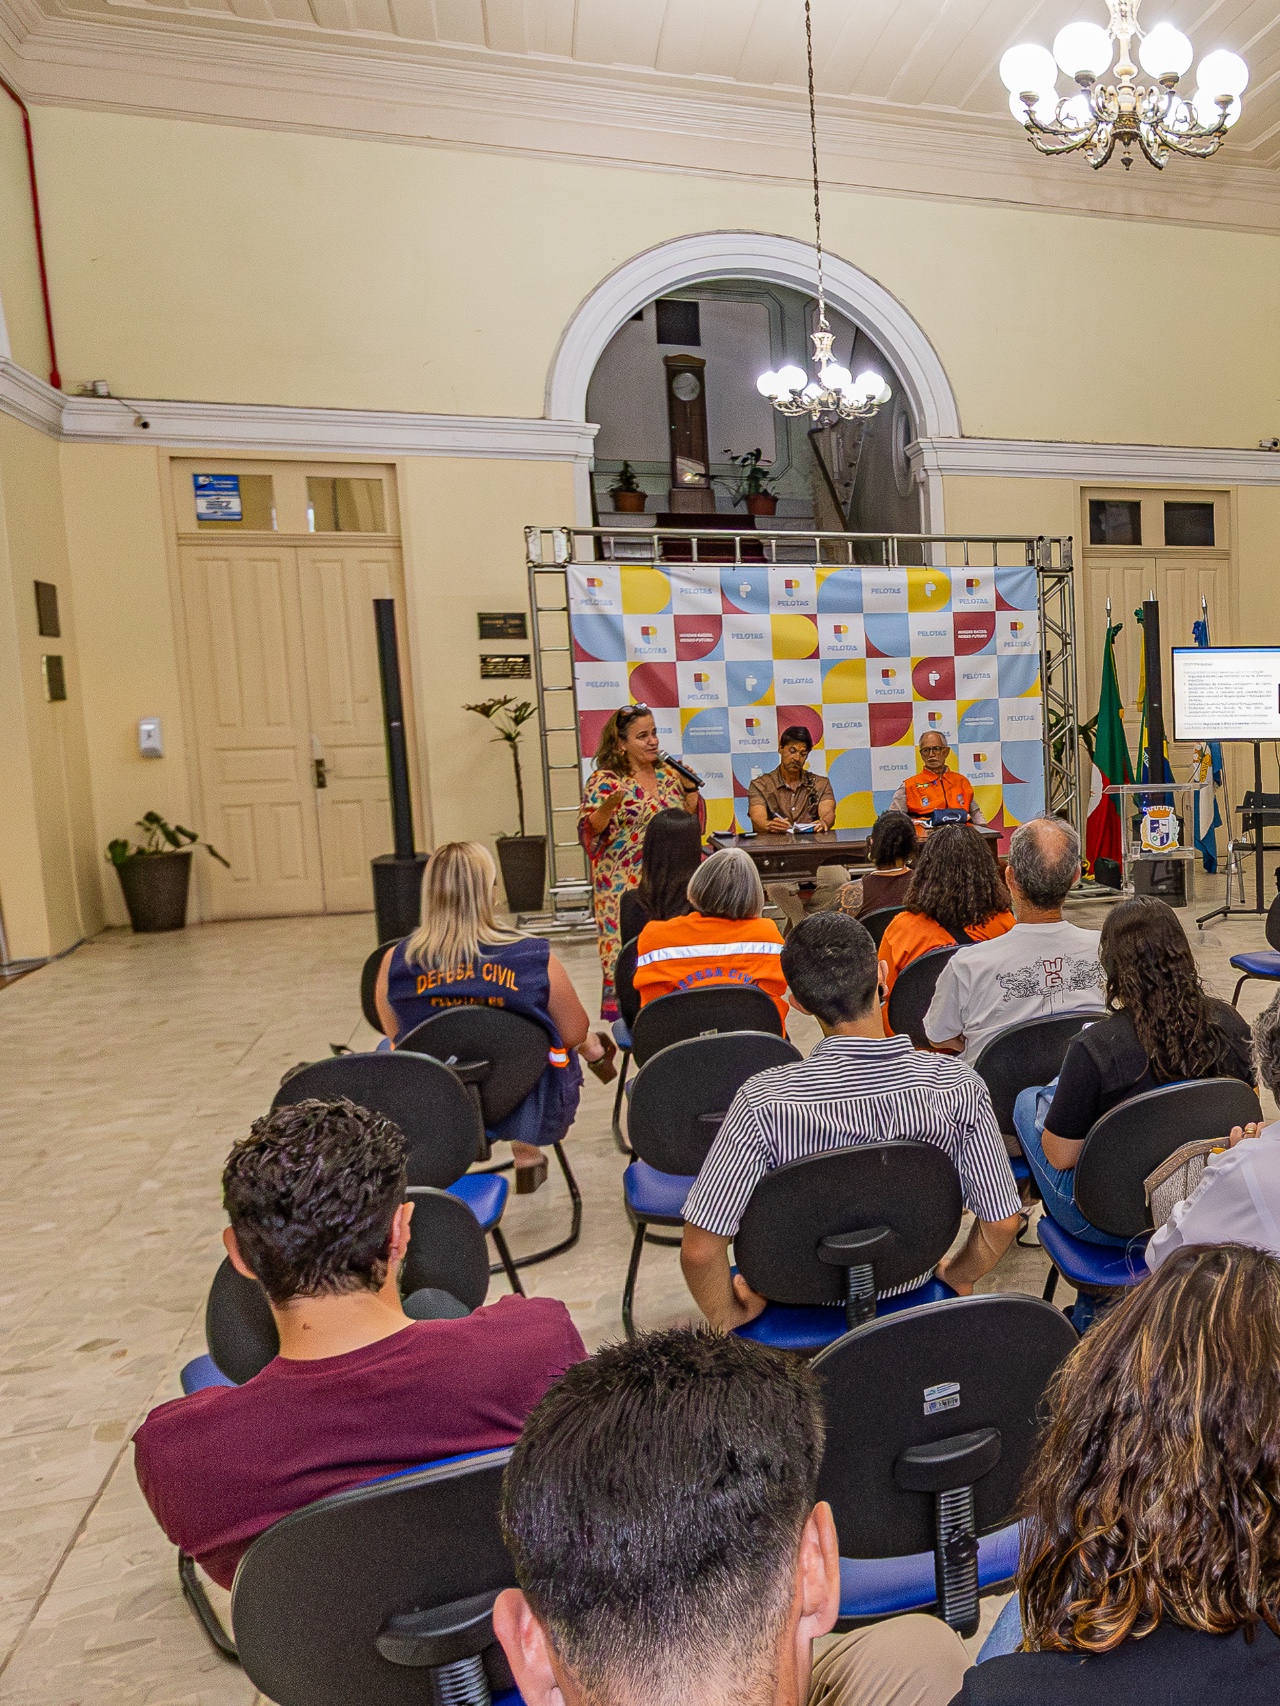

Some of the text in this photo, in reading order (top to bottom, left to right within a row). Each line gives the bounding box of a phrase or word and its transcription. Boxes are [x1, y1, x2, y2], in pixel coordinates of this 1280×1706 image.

[679, 587, 713, 595] PELOTAS
[416, 962, 519, 995] DEFESA CIVIL
[677, 967, 723, 991] EFESA
